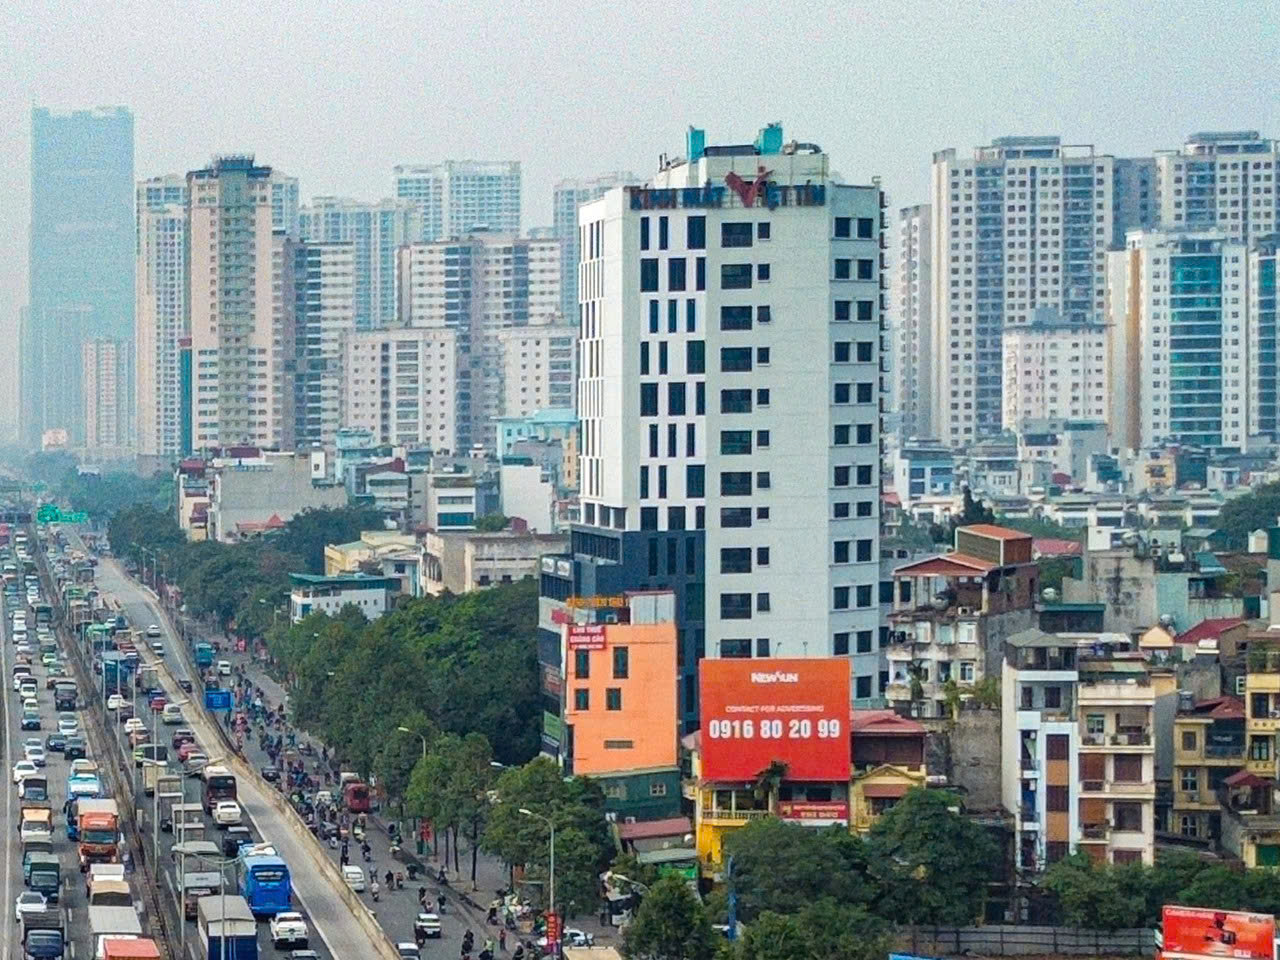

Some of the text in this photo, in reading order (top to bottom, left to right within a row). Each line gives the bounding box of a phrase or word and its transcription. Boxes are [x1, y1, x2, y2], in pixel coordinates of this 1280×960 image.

[760, 705, 775, 713] FOR
[709, 719, 840, 738] 0916 80 20 99
